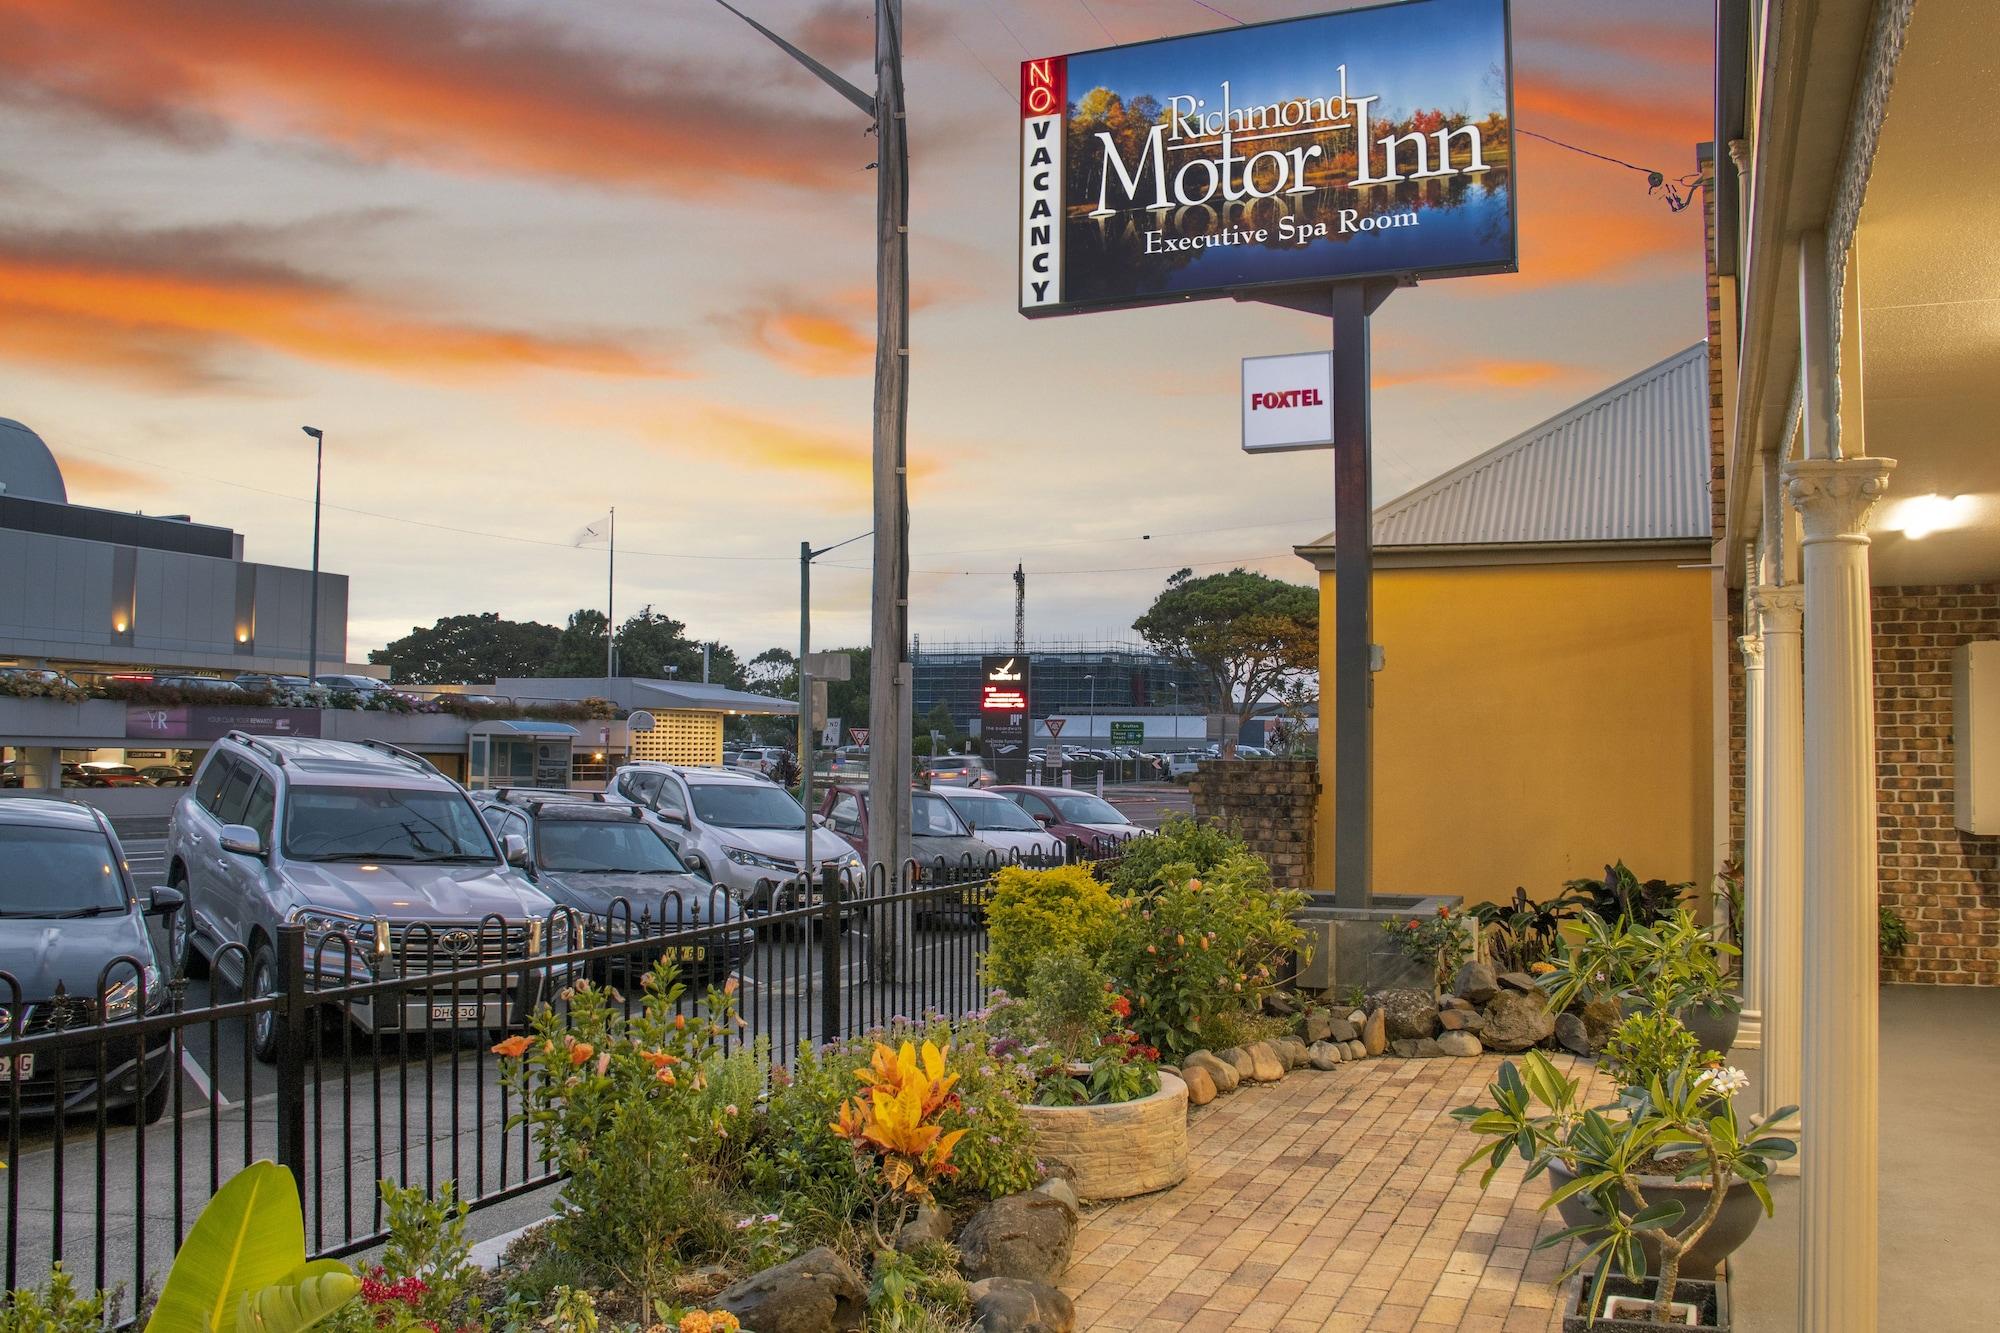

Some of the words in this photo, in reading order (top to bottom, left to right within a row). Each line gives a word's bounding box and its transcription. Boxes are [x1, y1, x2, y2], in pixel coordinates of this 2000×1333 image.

[1029, 60, 1051, 112] NO
[1167, 64, 1351, 142] Richmond
[1088, 124, 1322, 217] Motor
[1346, 95, 1492, 187] Inn
[1030, 121, 1052, 303] VACANCY
[1144, 224, 1268, 255] Executive
[1278, 213, 1328, 245] Spa
[1337, 208, 1420, 234] Room
[1251, 388, 1323, 411] FOXTEL
[147, 711, 168, 729] YR
